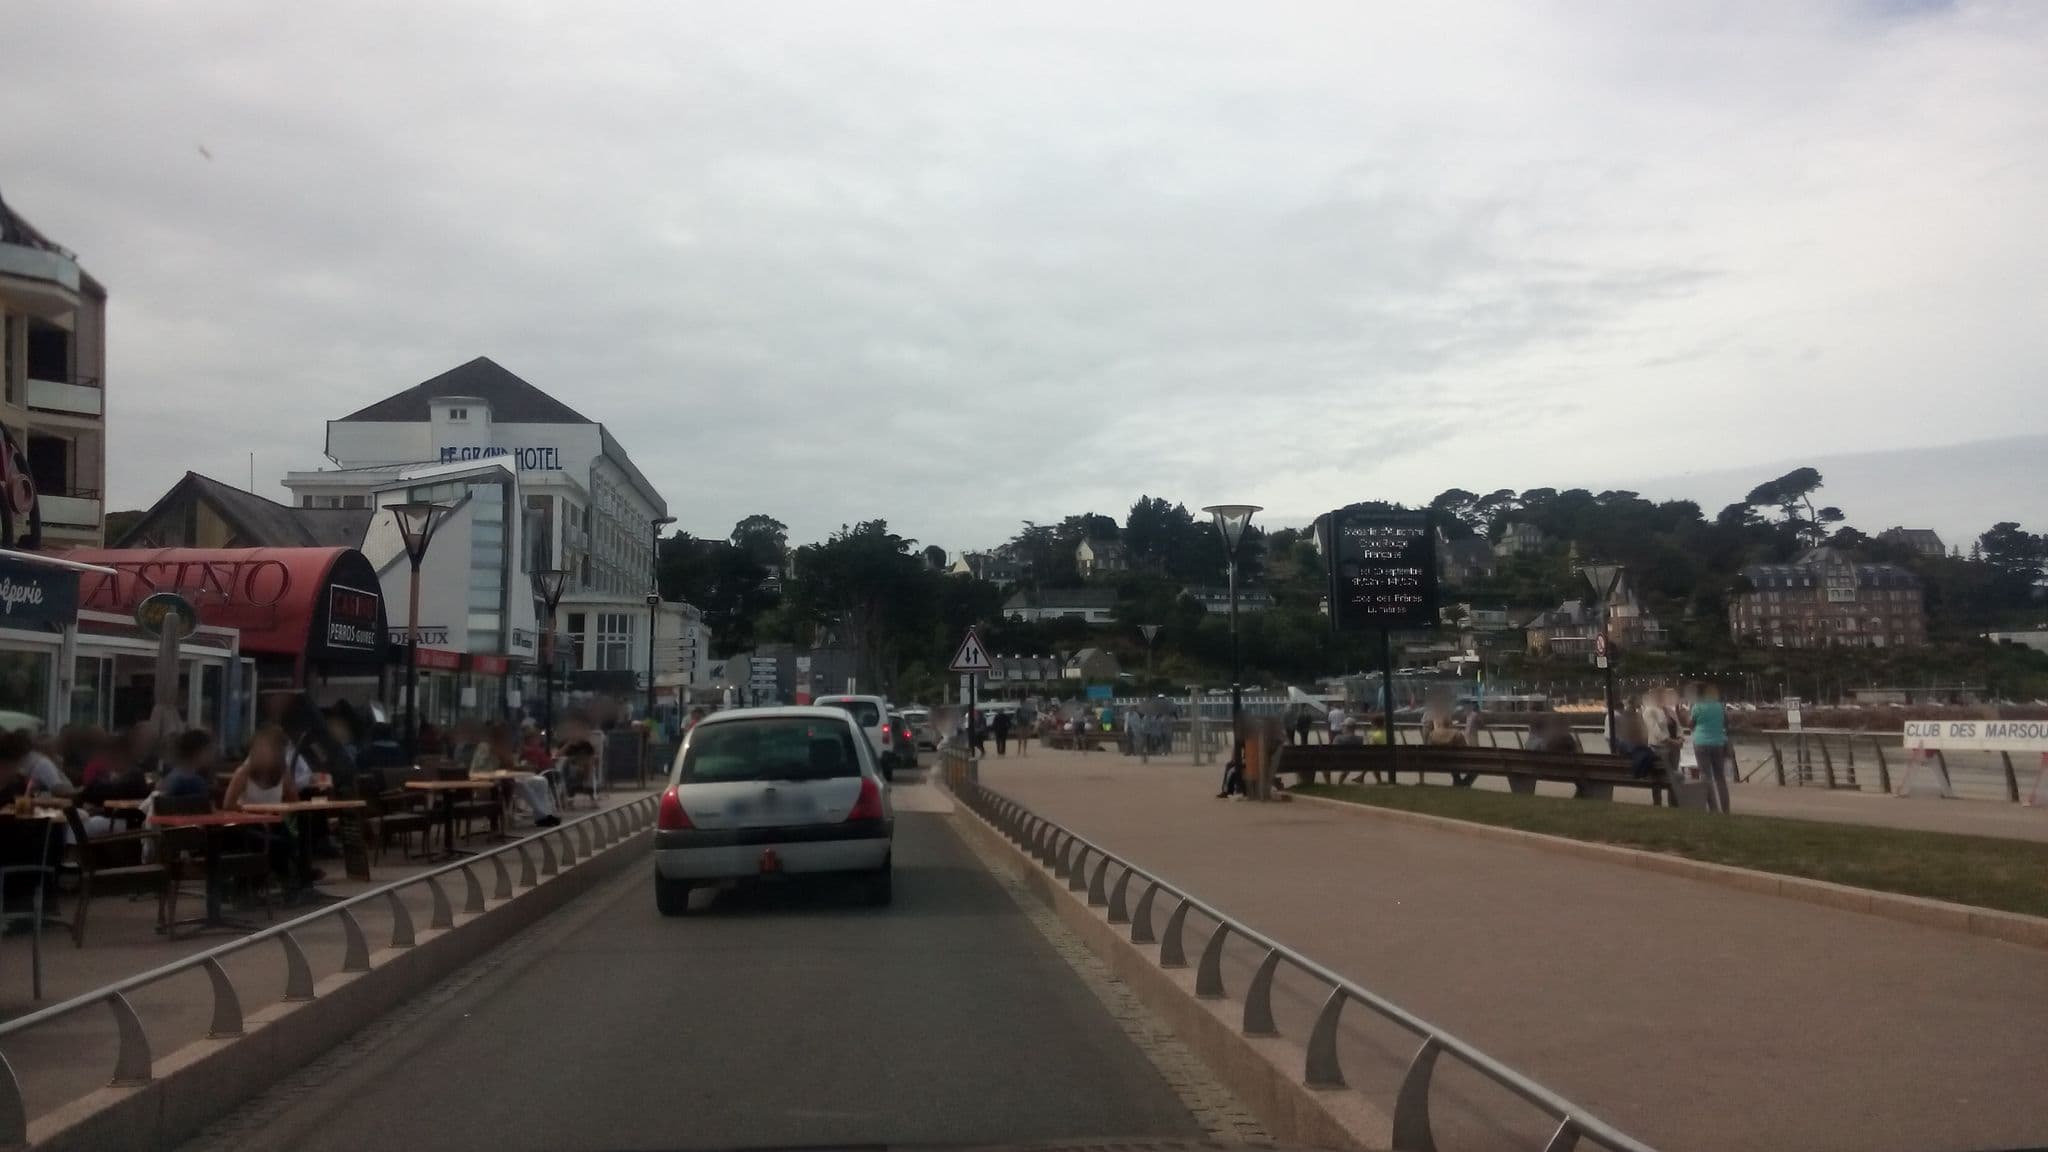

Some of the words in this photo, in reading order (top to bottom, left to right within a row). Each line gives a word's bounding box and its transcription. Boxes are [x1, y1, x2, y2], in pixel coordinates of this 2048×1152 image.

[514, 446, 563, 472] HOTEL
[83, 557, 291, 609] ASINO
[1906, 723, 1940, 737] CLUB
[1949, 723, 1976, 738] DES
